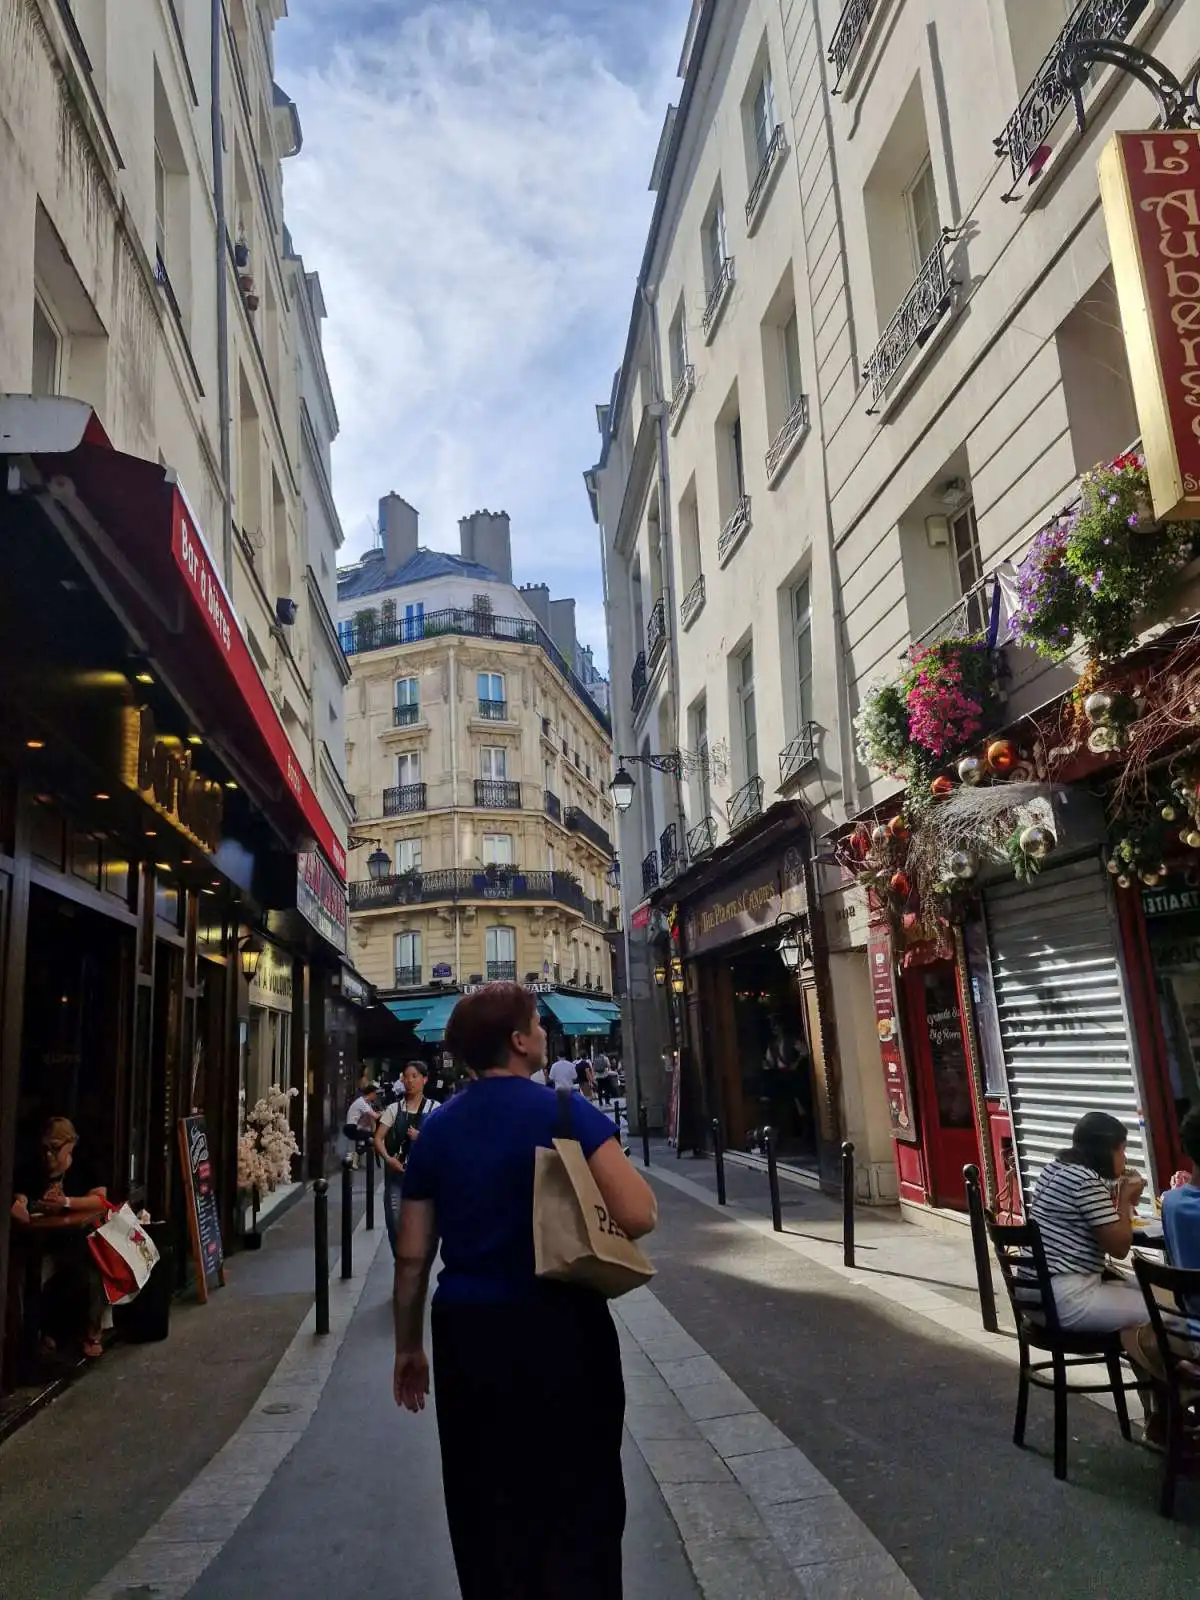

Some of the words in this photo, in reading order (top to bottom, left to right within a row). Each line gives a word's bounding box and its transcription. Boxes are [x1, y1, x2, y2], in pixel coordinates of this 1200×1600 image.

[181, 518, 198, 583] Bar
[200, 559, 207, 601] à
[207, 574, 231, 652] bières
